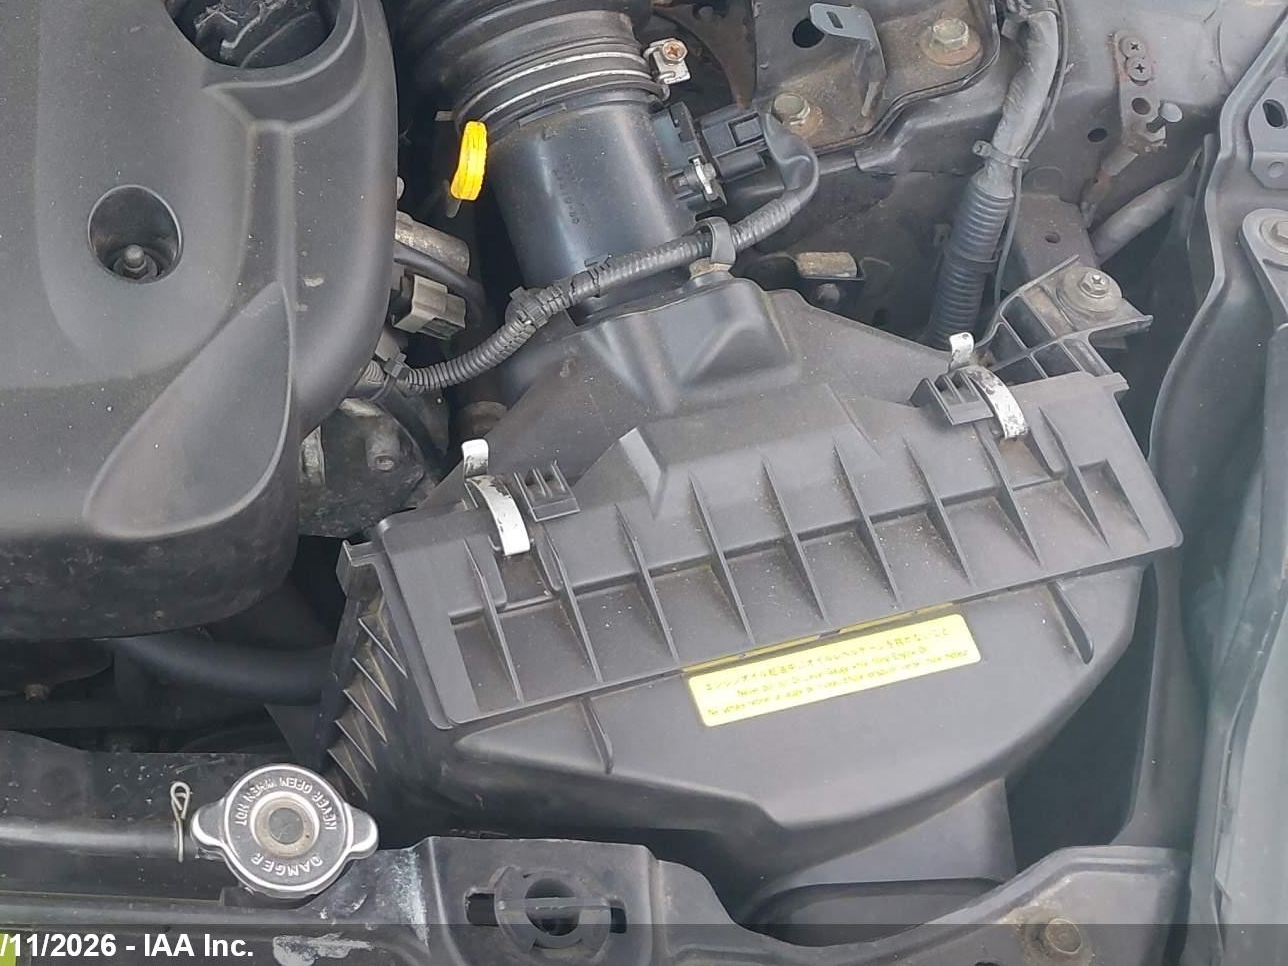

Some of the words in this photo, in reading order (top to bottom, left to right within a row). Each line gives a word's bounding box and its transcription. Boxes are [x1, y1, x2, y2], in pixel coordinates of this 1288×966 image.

[245, 777, 277, 804] WHEN
[279, 777, 314, 795] OPEN
[235, 803, 251, 827] HOT
[312, 791, 338, 831] NEVER
[250, 852, 325, 877] DANGER
